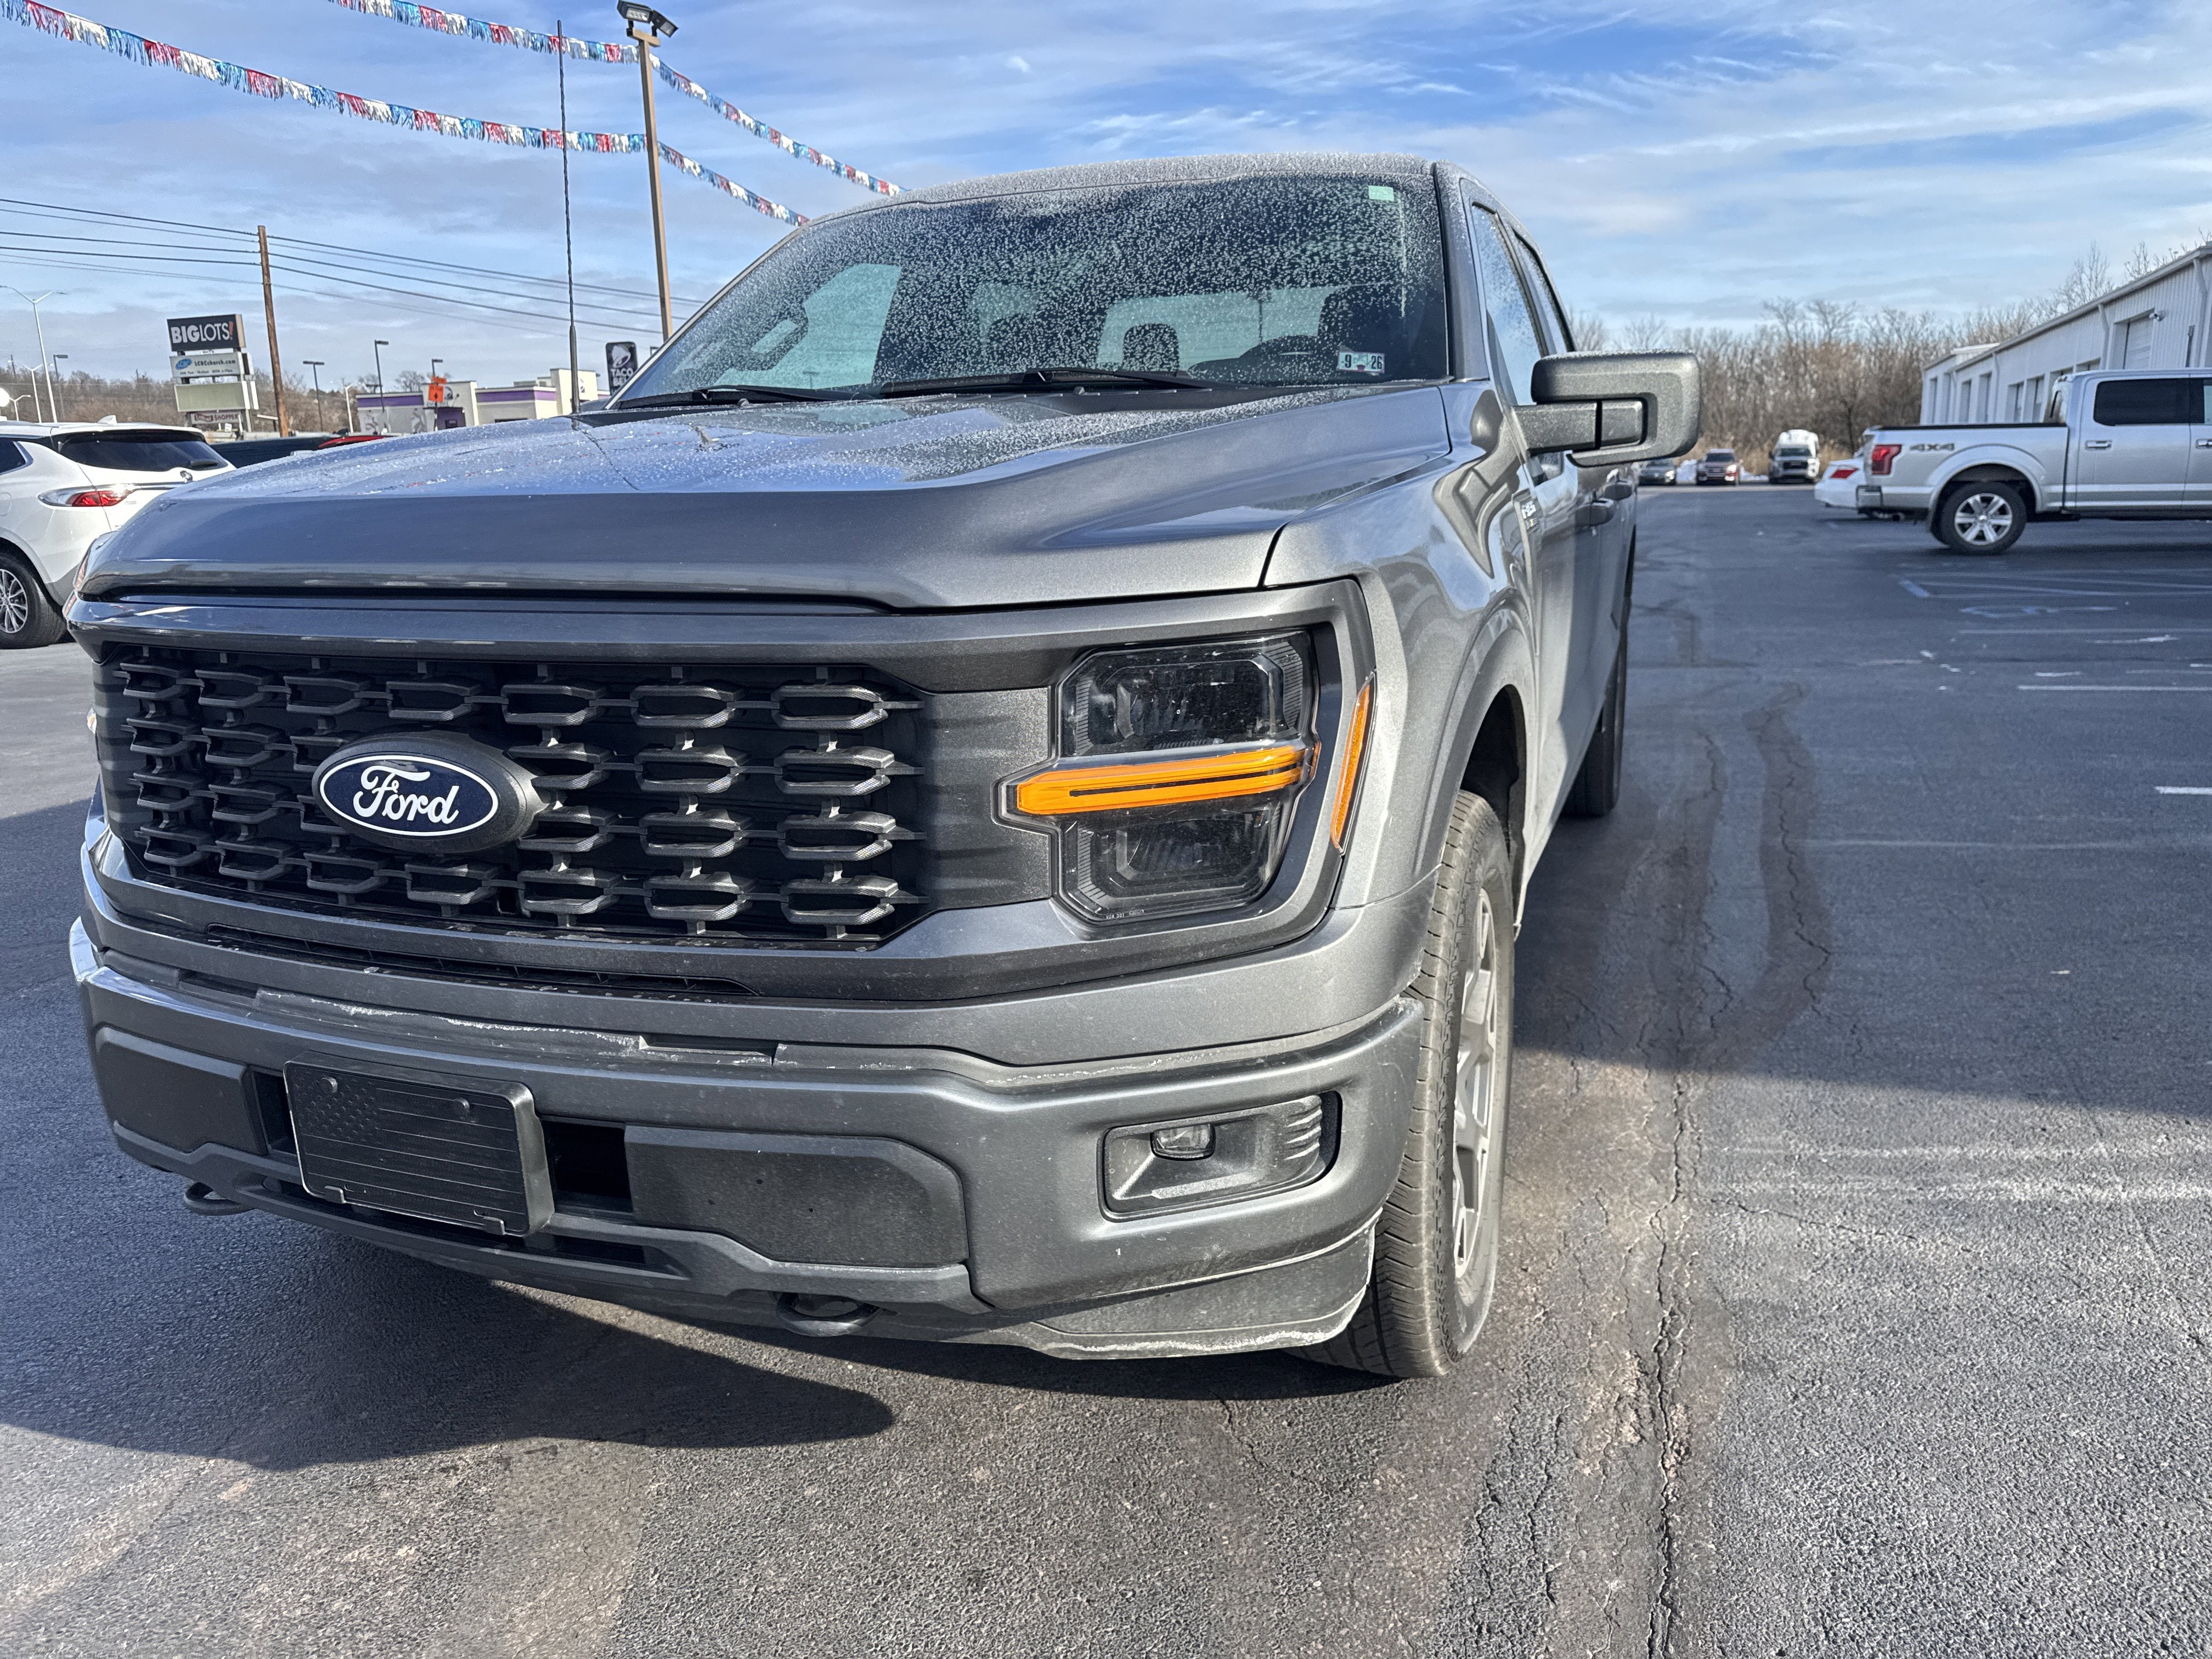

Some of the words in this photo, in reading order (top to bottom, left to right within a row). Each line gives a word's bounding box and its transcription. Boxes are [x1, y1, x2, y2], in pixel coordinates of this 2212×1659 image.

[1345, 354, 1352, 368] 9
[1371, 356, 1382, 369] 26
[610, 367, 633, 377] TACO
[353, 765, 460, 824] Ford
